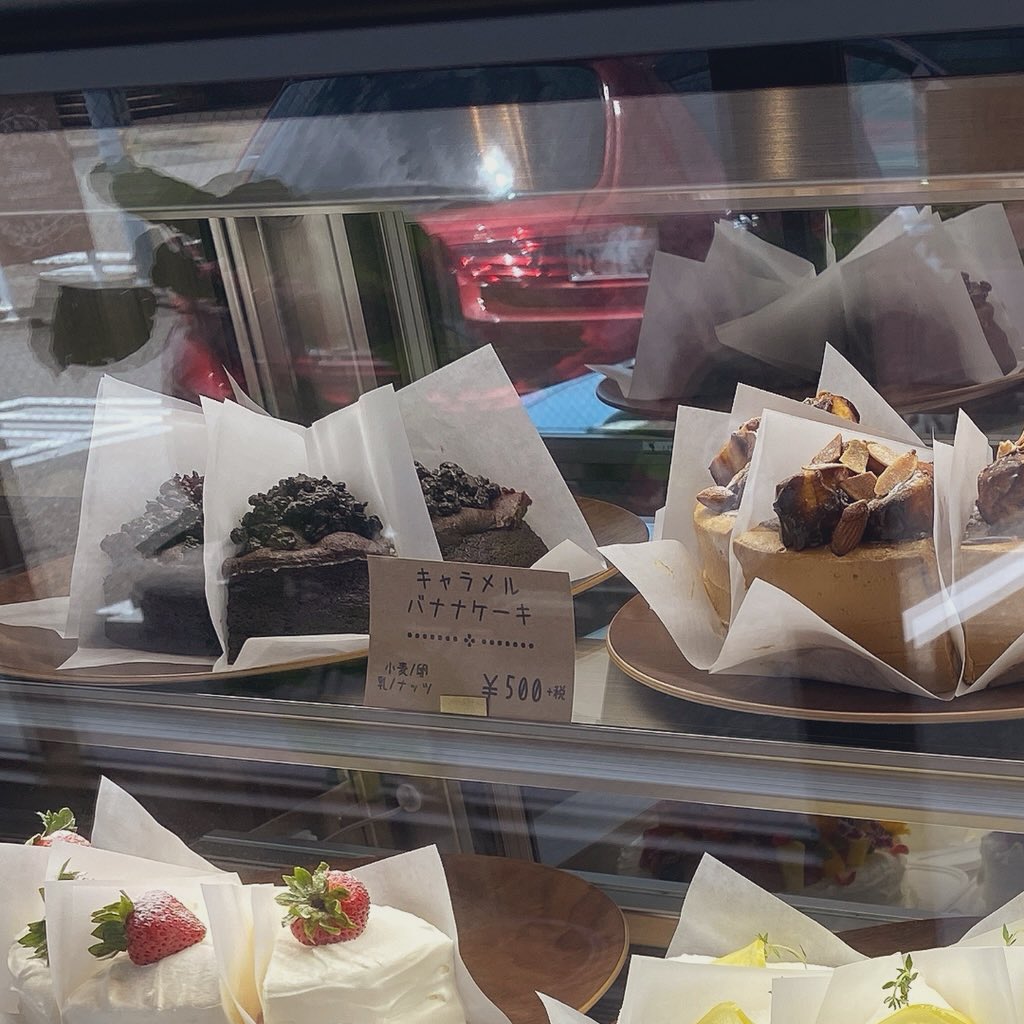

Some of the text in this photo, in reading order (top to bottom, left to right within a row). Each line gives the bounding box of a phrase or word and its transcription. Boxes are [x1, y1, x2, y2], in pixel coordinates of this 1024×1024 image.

[417, 568, 519, 595] キャラメル
[408, 595, 531, 625] バナナケーキ
[385, 661, 429, 678] 小麦/卵
[377, 676, 432, 695] 乳/ナッツ
